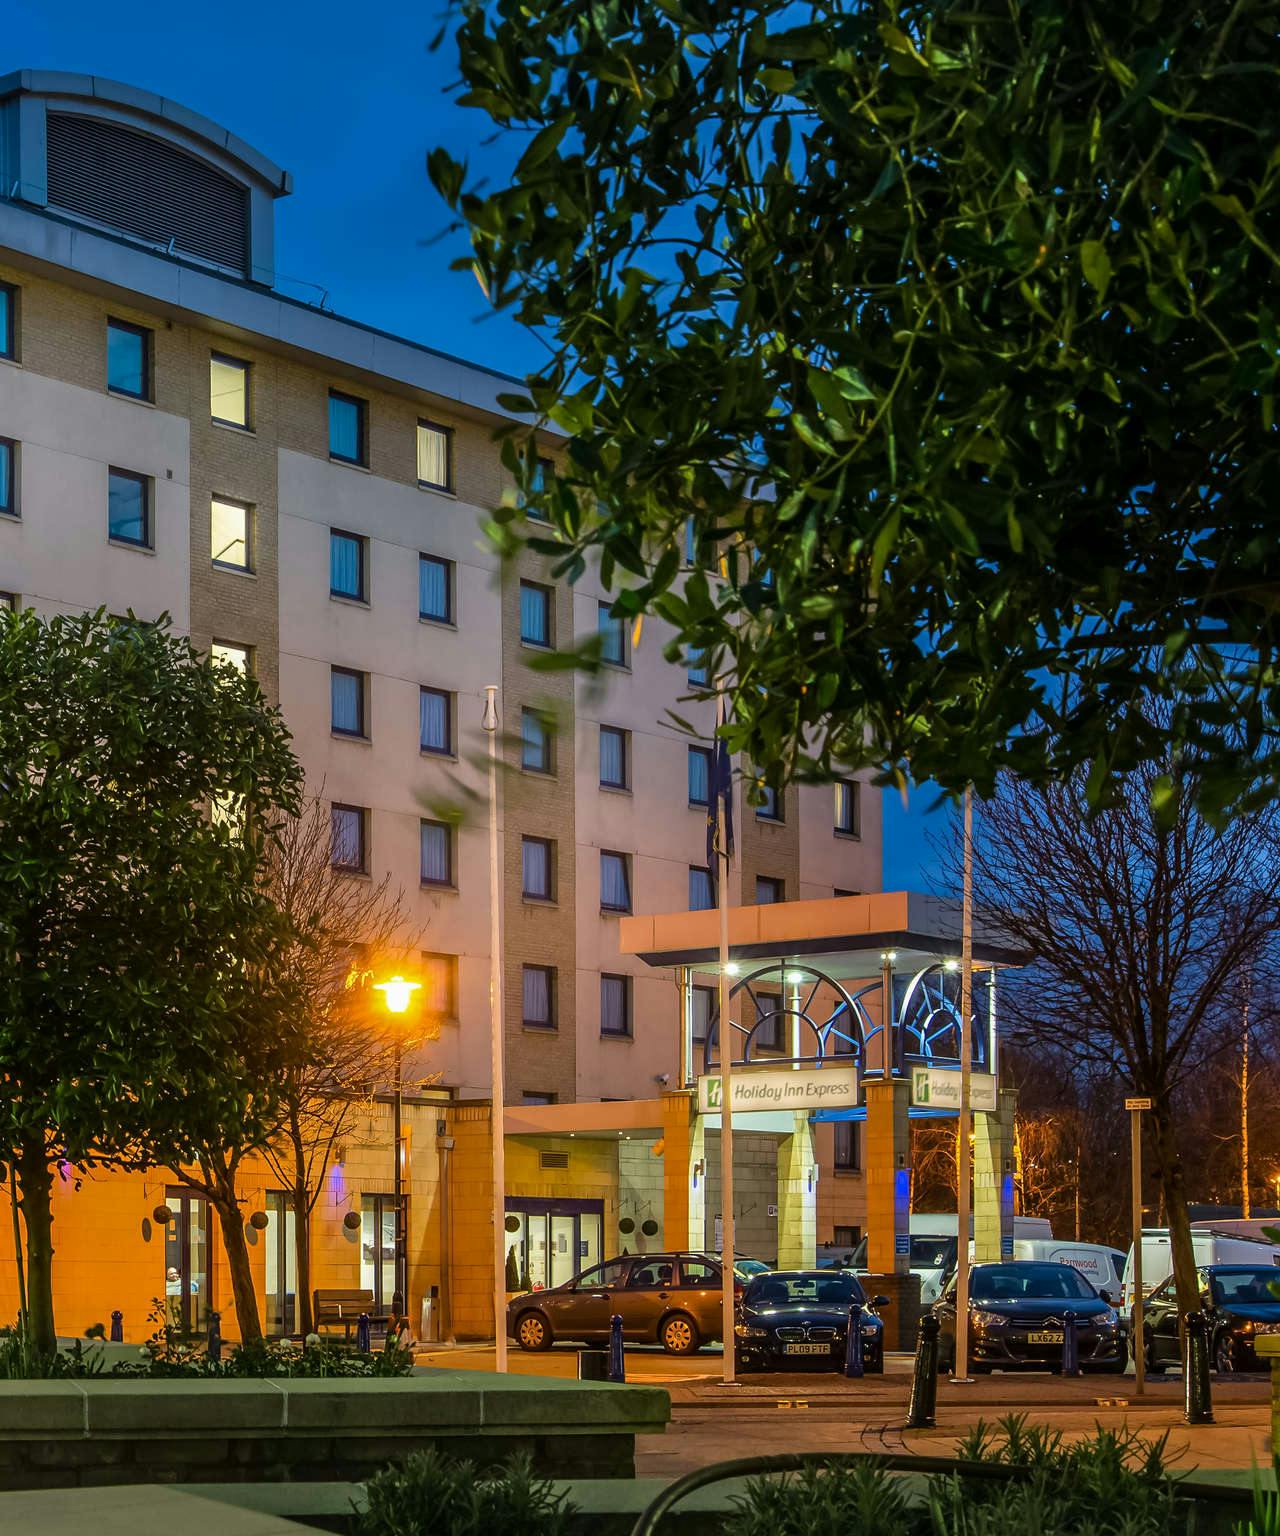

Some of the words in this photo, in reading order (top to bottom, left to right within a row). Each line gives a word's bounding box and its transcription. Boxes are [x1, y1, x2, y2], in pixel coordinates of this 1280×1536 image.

[734, 1084, 783, 1101] Holiday
[784, 1082, 804, 1097] Inn
[806, 1082, 849, 1098] Express
[931, 1080, 958, 1101] Holiday
[1031, 1334, 1053, 1343] LX62
[788, 1345, 810, 1354] PL09
